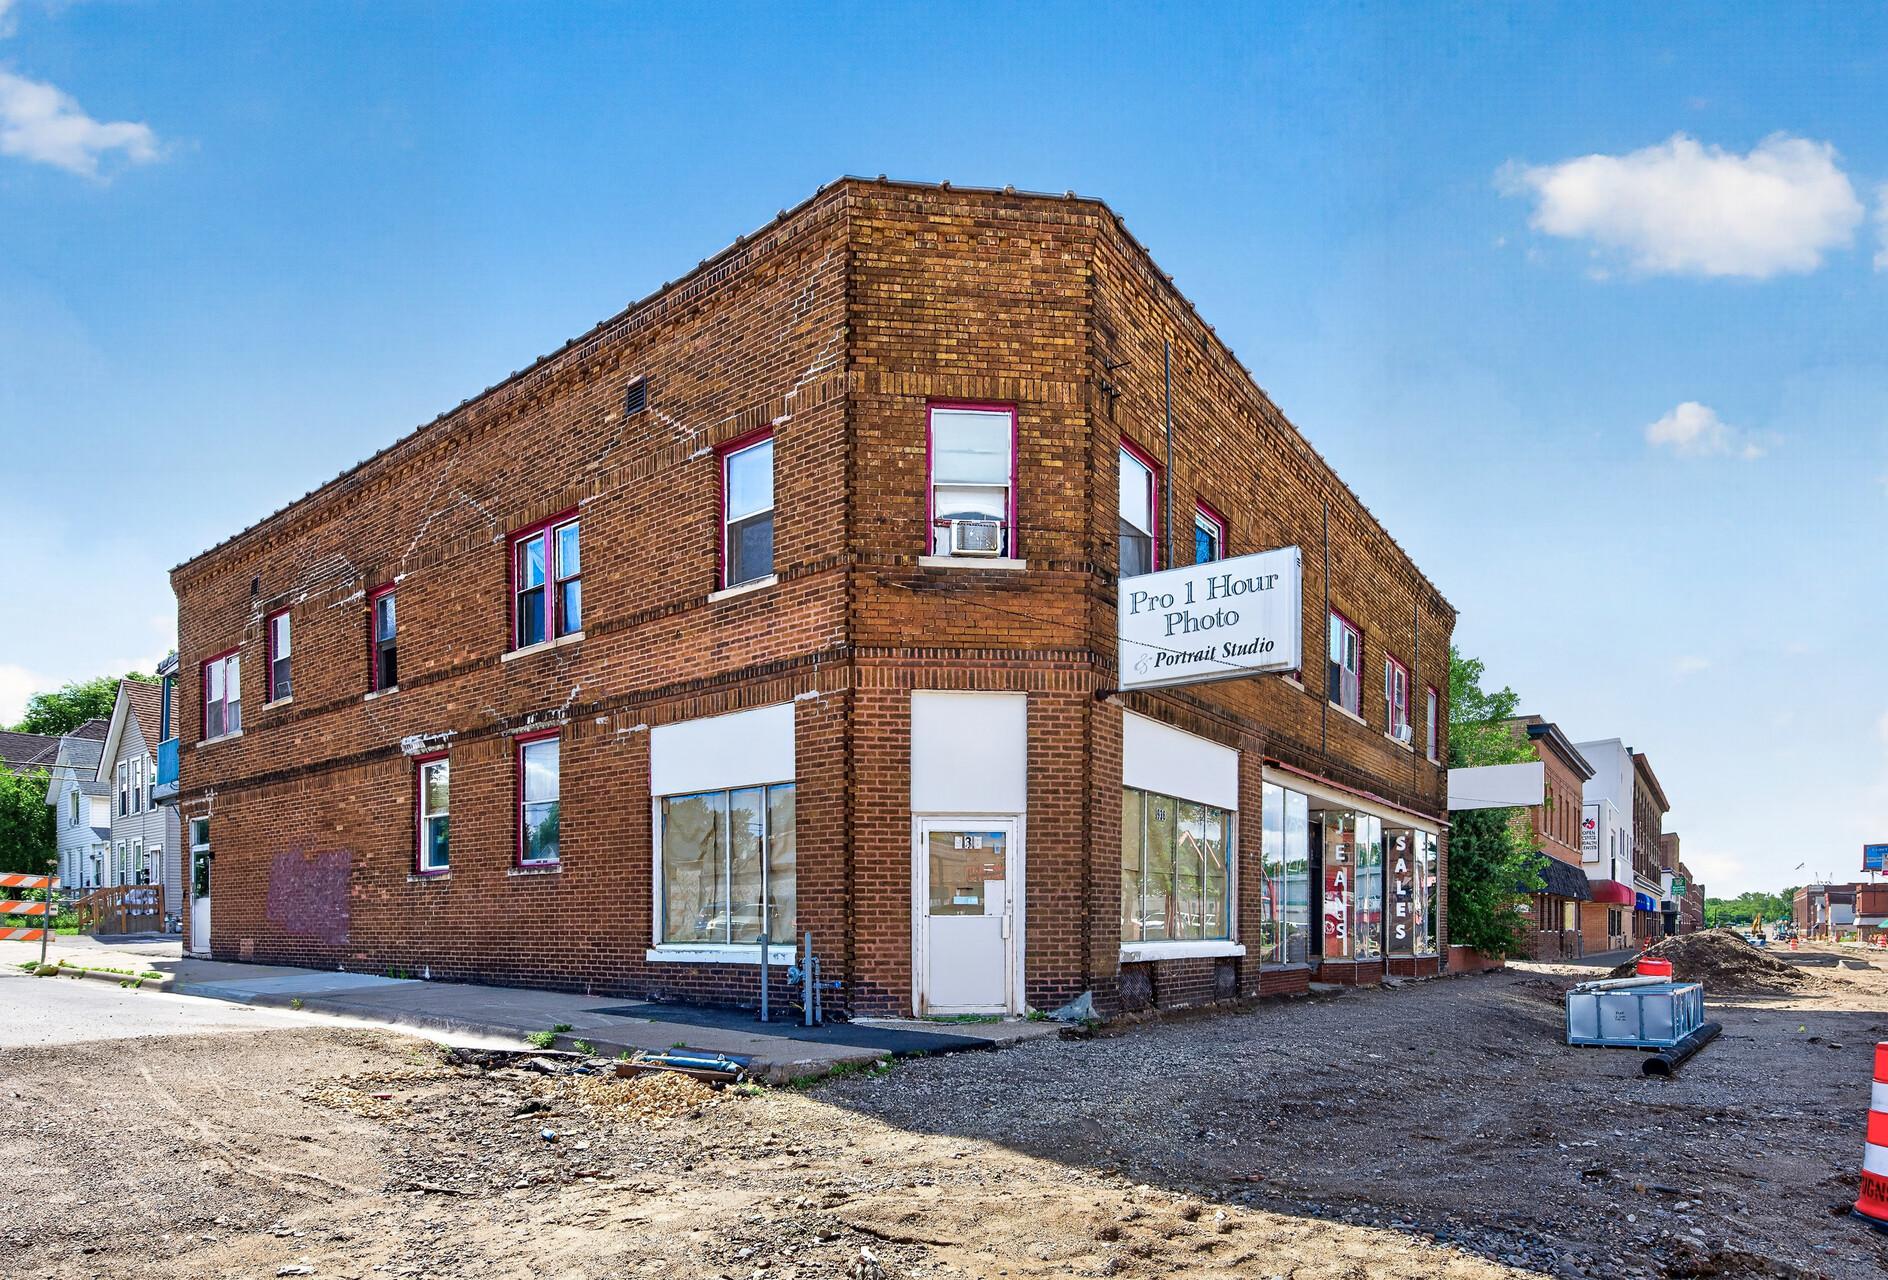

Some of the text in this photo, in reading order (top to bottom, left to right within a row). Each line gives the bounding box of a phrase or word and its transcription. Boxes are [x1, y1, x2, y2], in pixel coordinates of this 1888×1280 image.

[1130, 573, 1279, 615] Pro 1 Hour
[1164, 607, 1240, 637] Photo
[1154, 644, 1216, 668] Portrait
[1222, 636, 1275, 659] Studio
[1395, 835, 1407, 940] SALES
